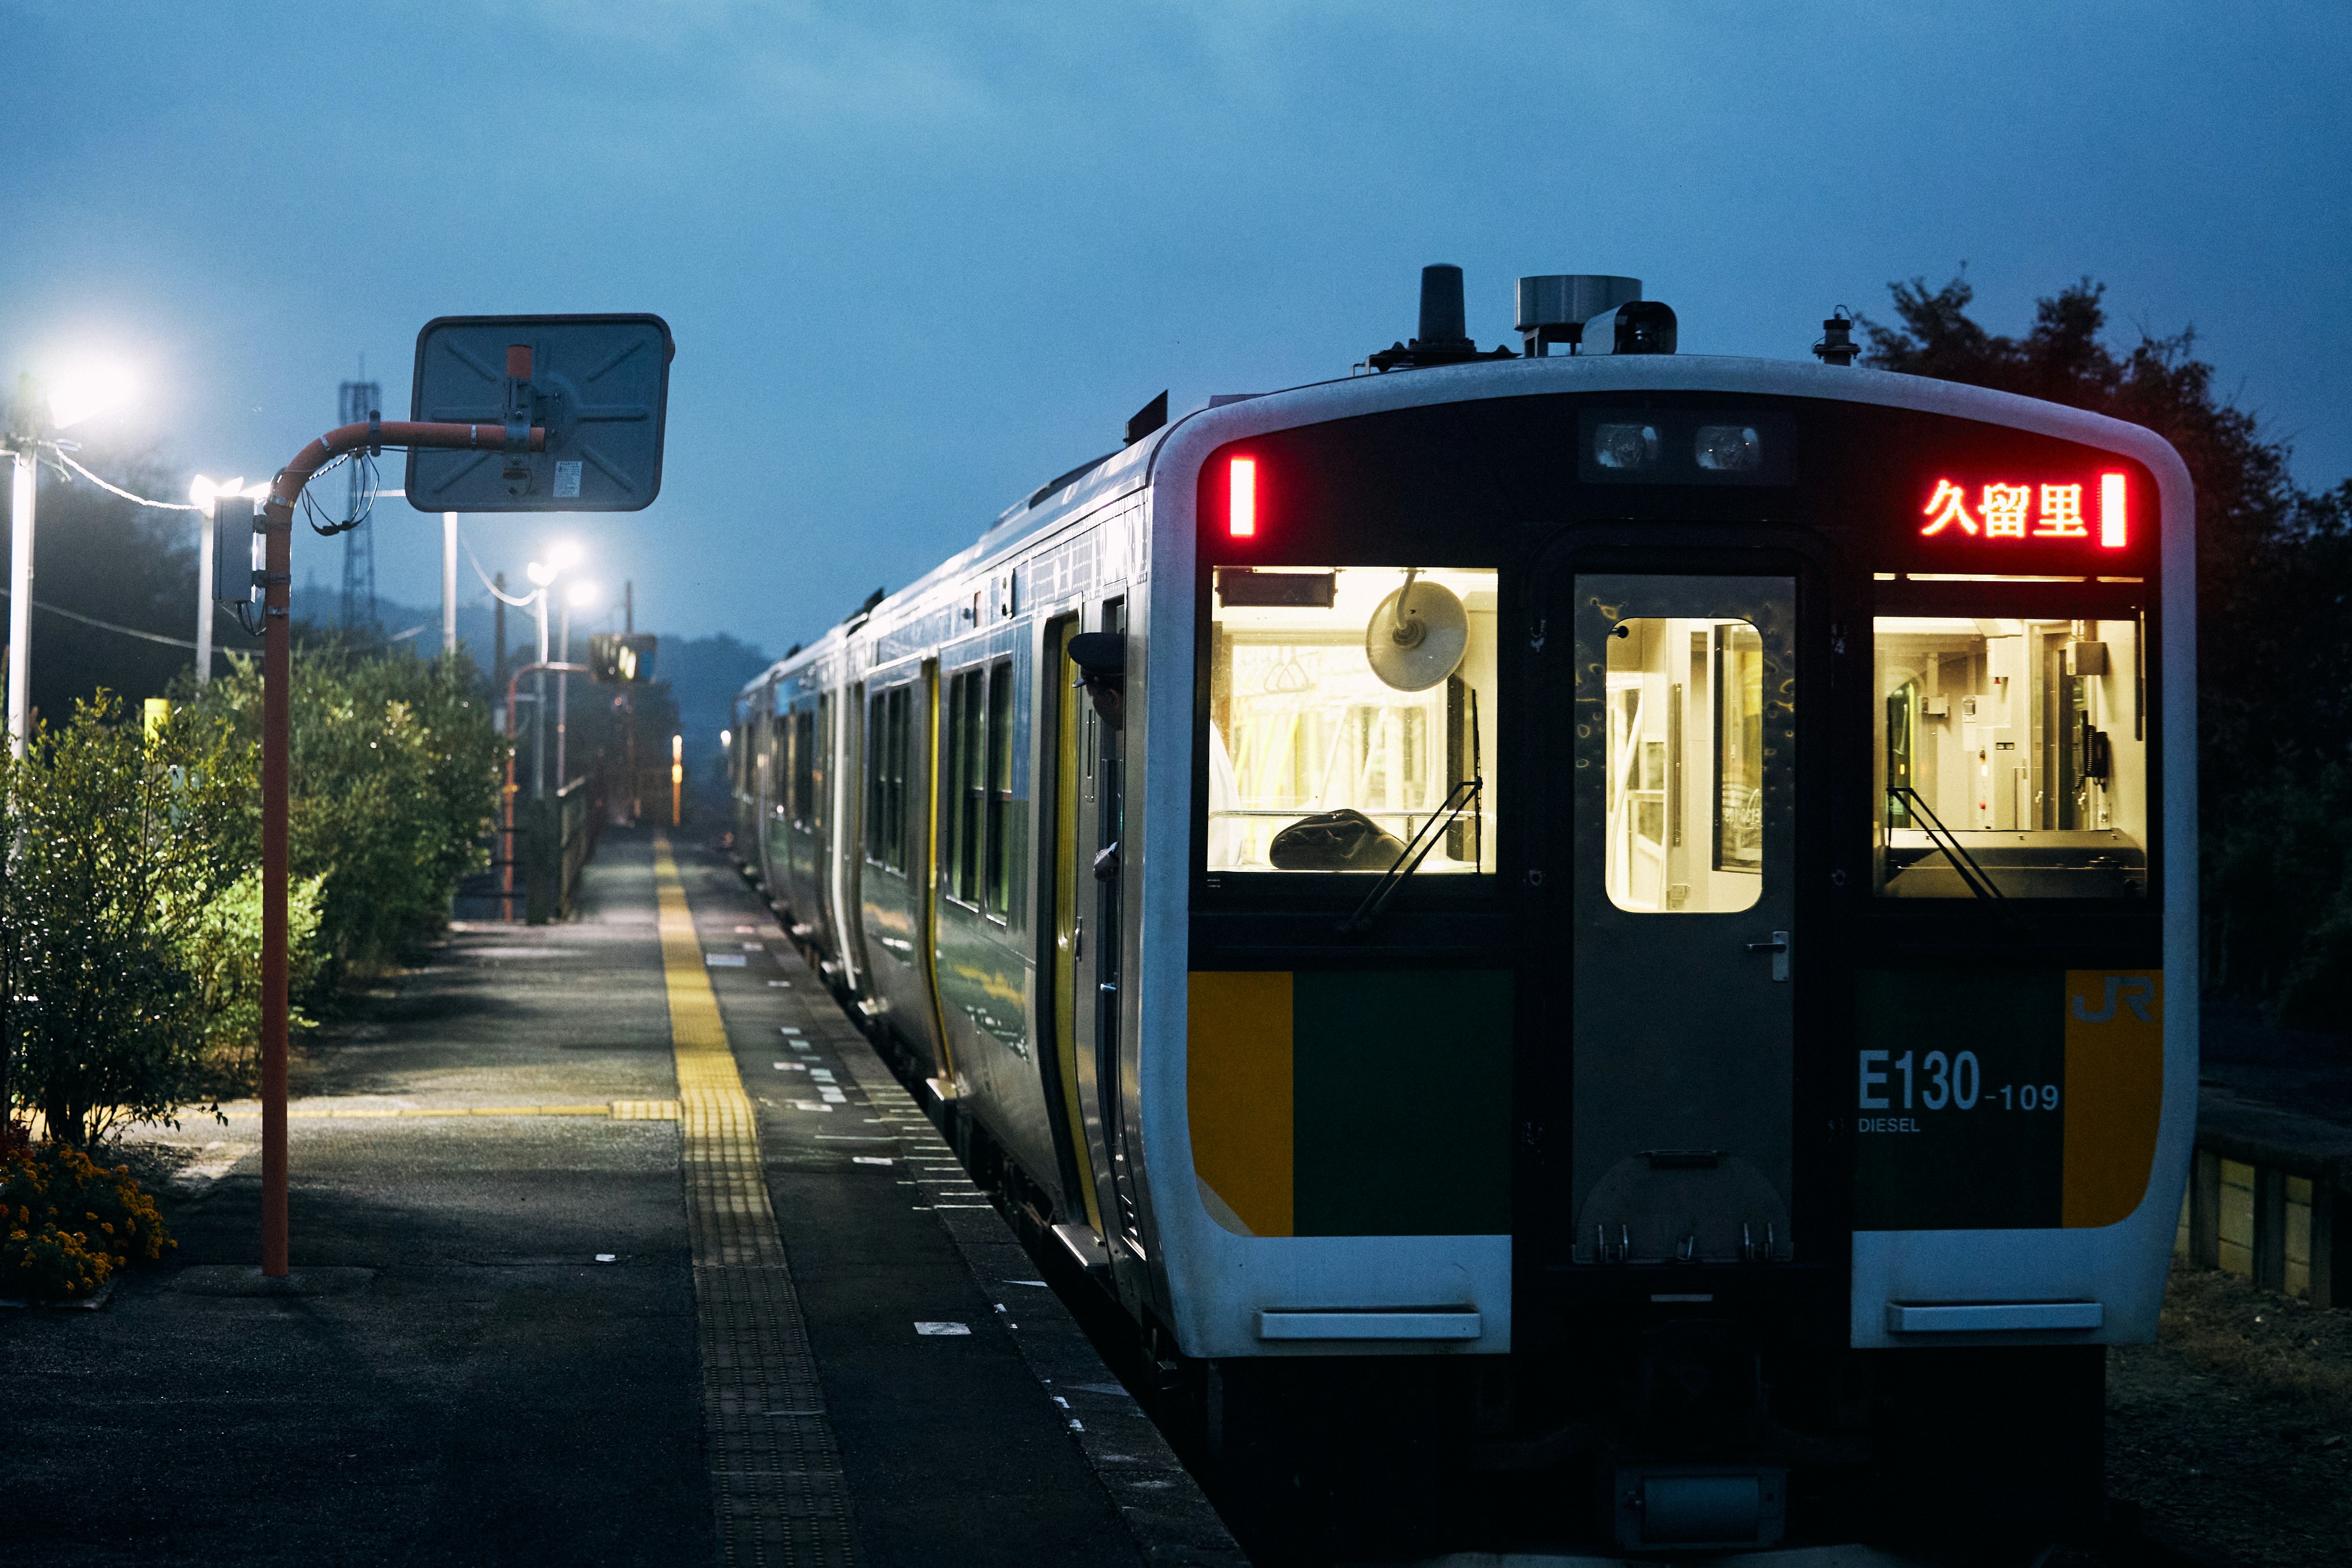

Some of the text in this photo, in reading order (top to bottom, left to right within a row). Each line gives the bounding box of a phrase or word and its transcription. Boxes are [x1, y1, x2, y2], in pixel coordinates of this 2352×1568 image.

[1921, 478, 2088, 537] 久留里
[2072, 976, 2155, 1023] JR
[1858, 1117, 1921, 1132] DIESEL
